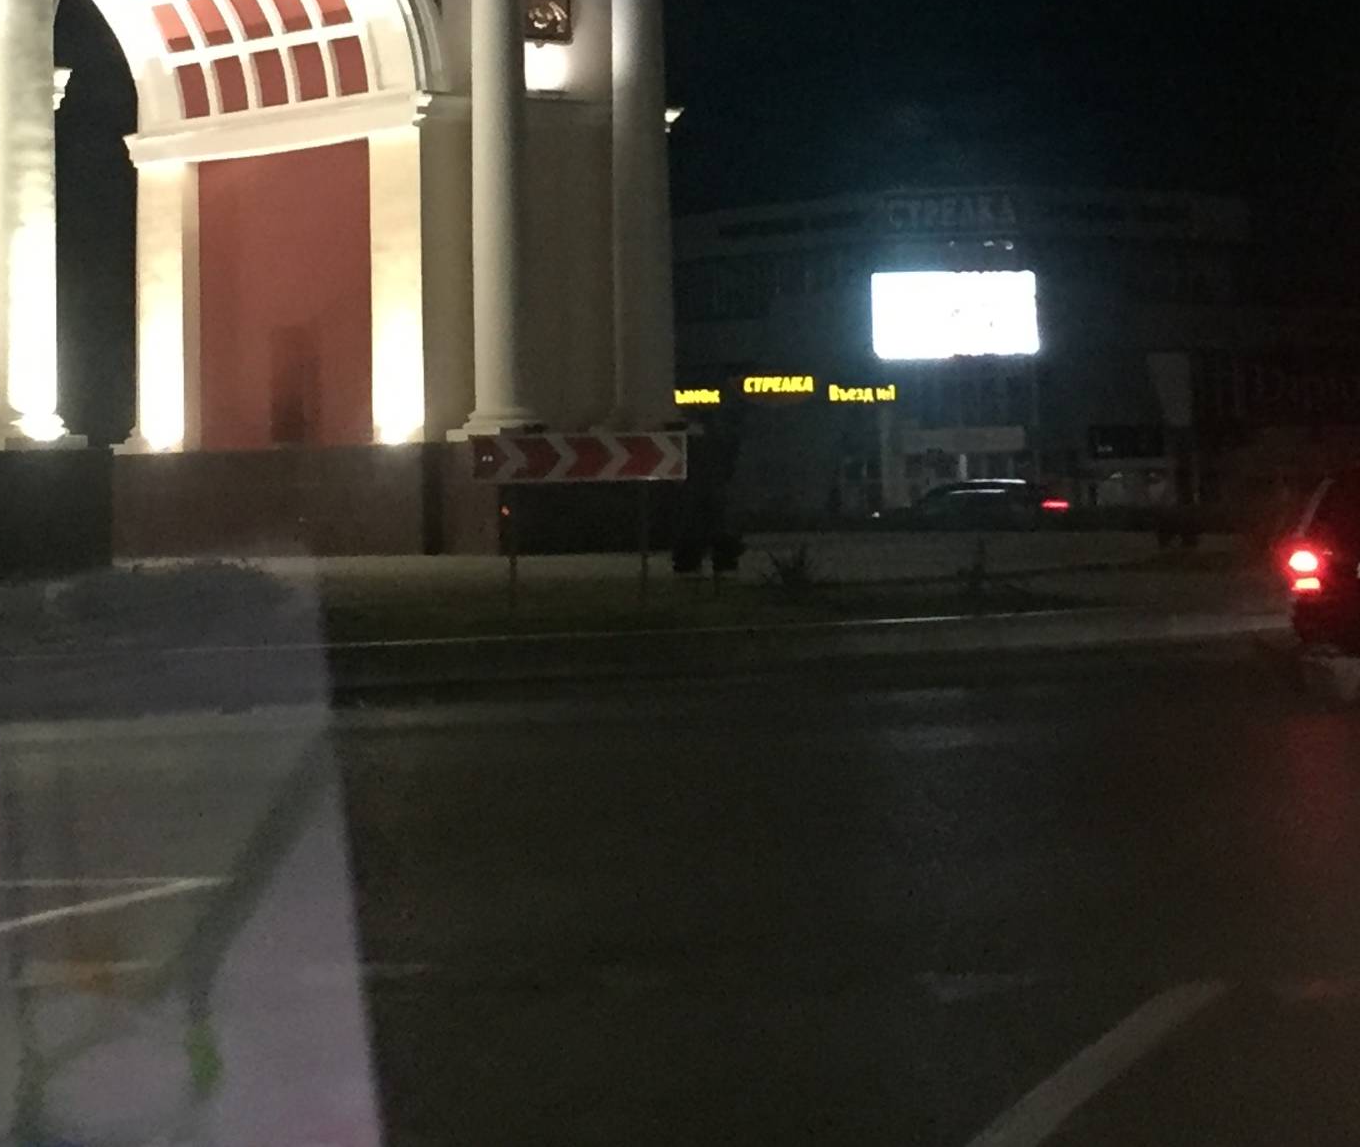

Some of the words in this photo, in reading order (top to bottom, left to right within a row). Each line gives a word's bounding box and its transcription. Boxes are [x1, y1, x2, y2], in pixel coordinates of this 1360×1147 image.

[743, 376, 814, 393] СТРЕЛКА
[673, 388, 720, 404] ынок
[829, 384, 874, 403] Въезд
